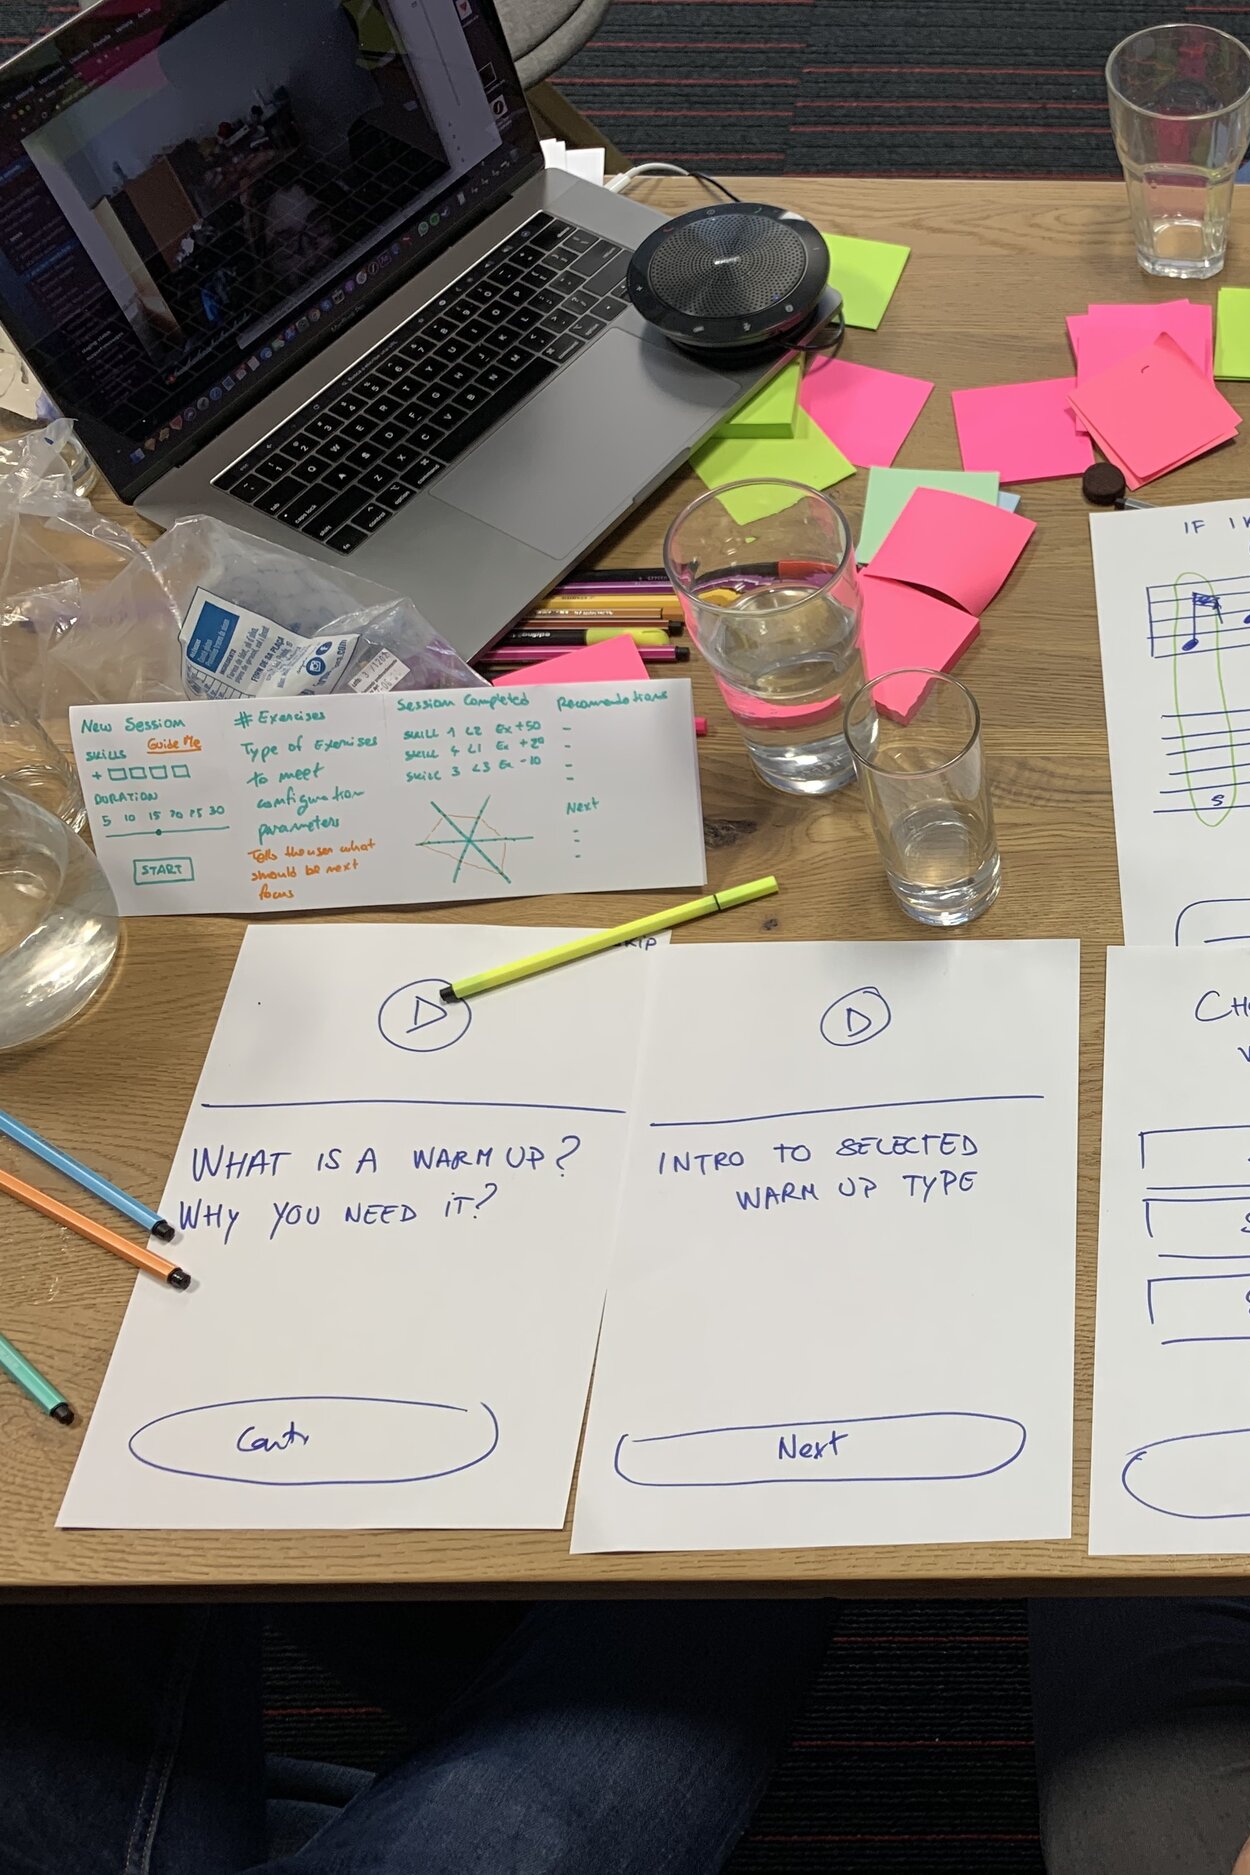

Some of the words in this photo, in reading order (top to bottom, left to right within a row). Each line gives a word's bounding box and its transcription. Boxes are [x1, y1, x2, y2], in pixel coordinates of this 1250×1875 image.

[1184, 520, 1205, 533] IF
[397, 699, 455, 712] Session
[464, 692, 529, 710] Completed
[81, 719, 112, 734] New
[125, 717, 185, 732] Session
[258, 711, 325, 724] Exercises
[147, 736, 179, 751] Guide
[182, 735, 200, 750] Me
[240, 742, 278, 763] Type
[288, 735, 303, 752] of
[314, 736, 377, 751] Exercises
[247, 772, 268, 787] to
[279, 762, 324, 783] meet
[452, 766, 460, 776] 3
[257, 786, 364, 816] configuration
[567, 797, 599, 814] Next
[102, 816, 111, 826] 5
[124, 812, 136, 822] 10
[149, 811, 161, 820] 15
[209, 806, 224, 815] 30
[258, 816, 339, 845] parameters
[248, 849, 278, 863] Tells
[340, 838, 375, 852] what
[140, 864, 183, 876] START
[251, 866, 297, 881] should
[305, 865, 320, 876] be
[326, 859, 358, 873] next
[259, 883, 294, 900] focus
[193, 1145, 292, 1182] WHAT
[318, 1148, 342, 1171] IS
[356, 1148, 377, 1174] A
[414, 1147, 493, 1170] WARM
[659, 1151, 744, 1175] INTRO
[773, 1144, 811, 1163] TO
[836, 1132, 978, 1156] SELECTED
[736, 1182, 819, 1210] WARM
[838, 1177, 877, 1198] UP
[902, 1170, 978, 1203] TYPE
[180, 1198, 239, 1245] WHY
[270, 1202, 320, 1240] YOU
[344, 1203, 417, 1224] NEED
[778, 1430, 848, 1459] Next
